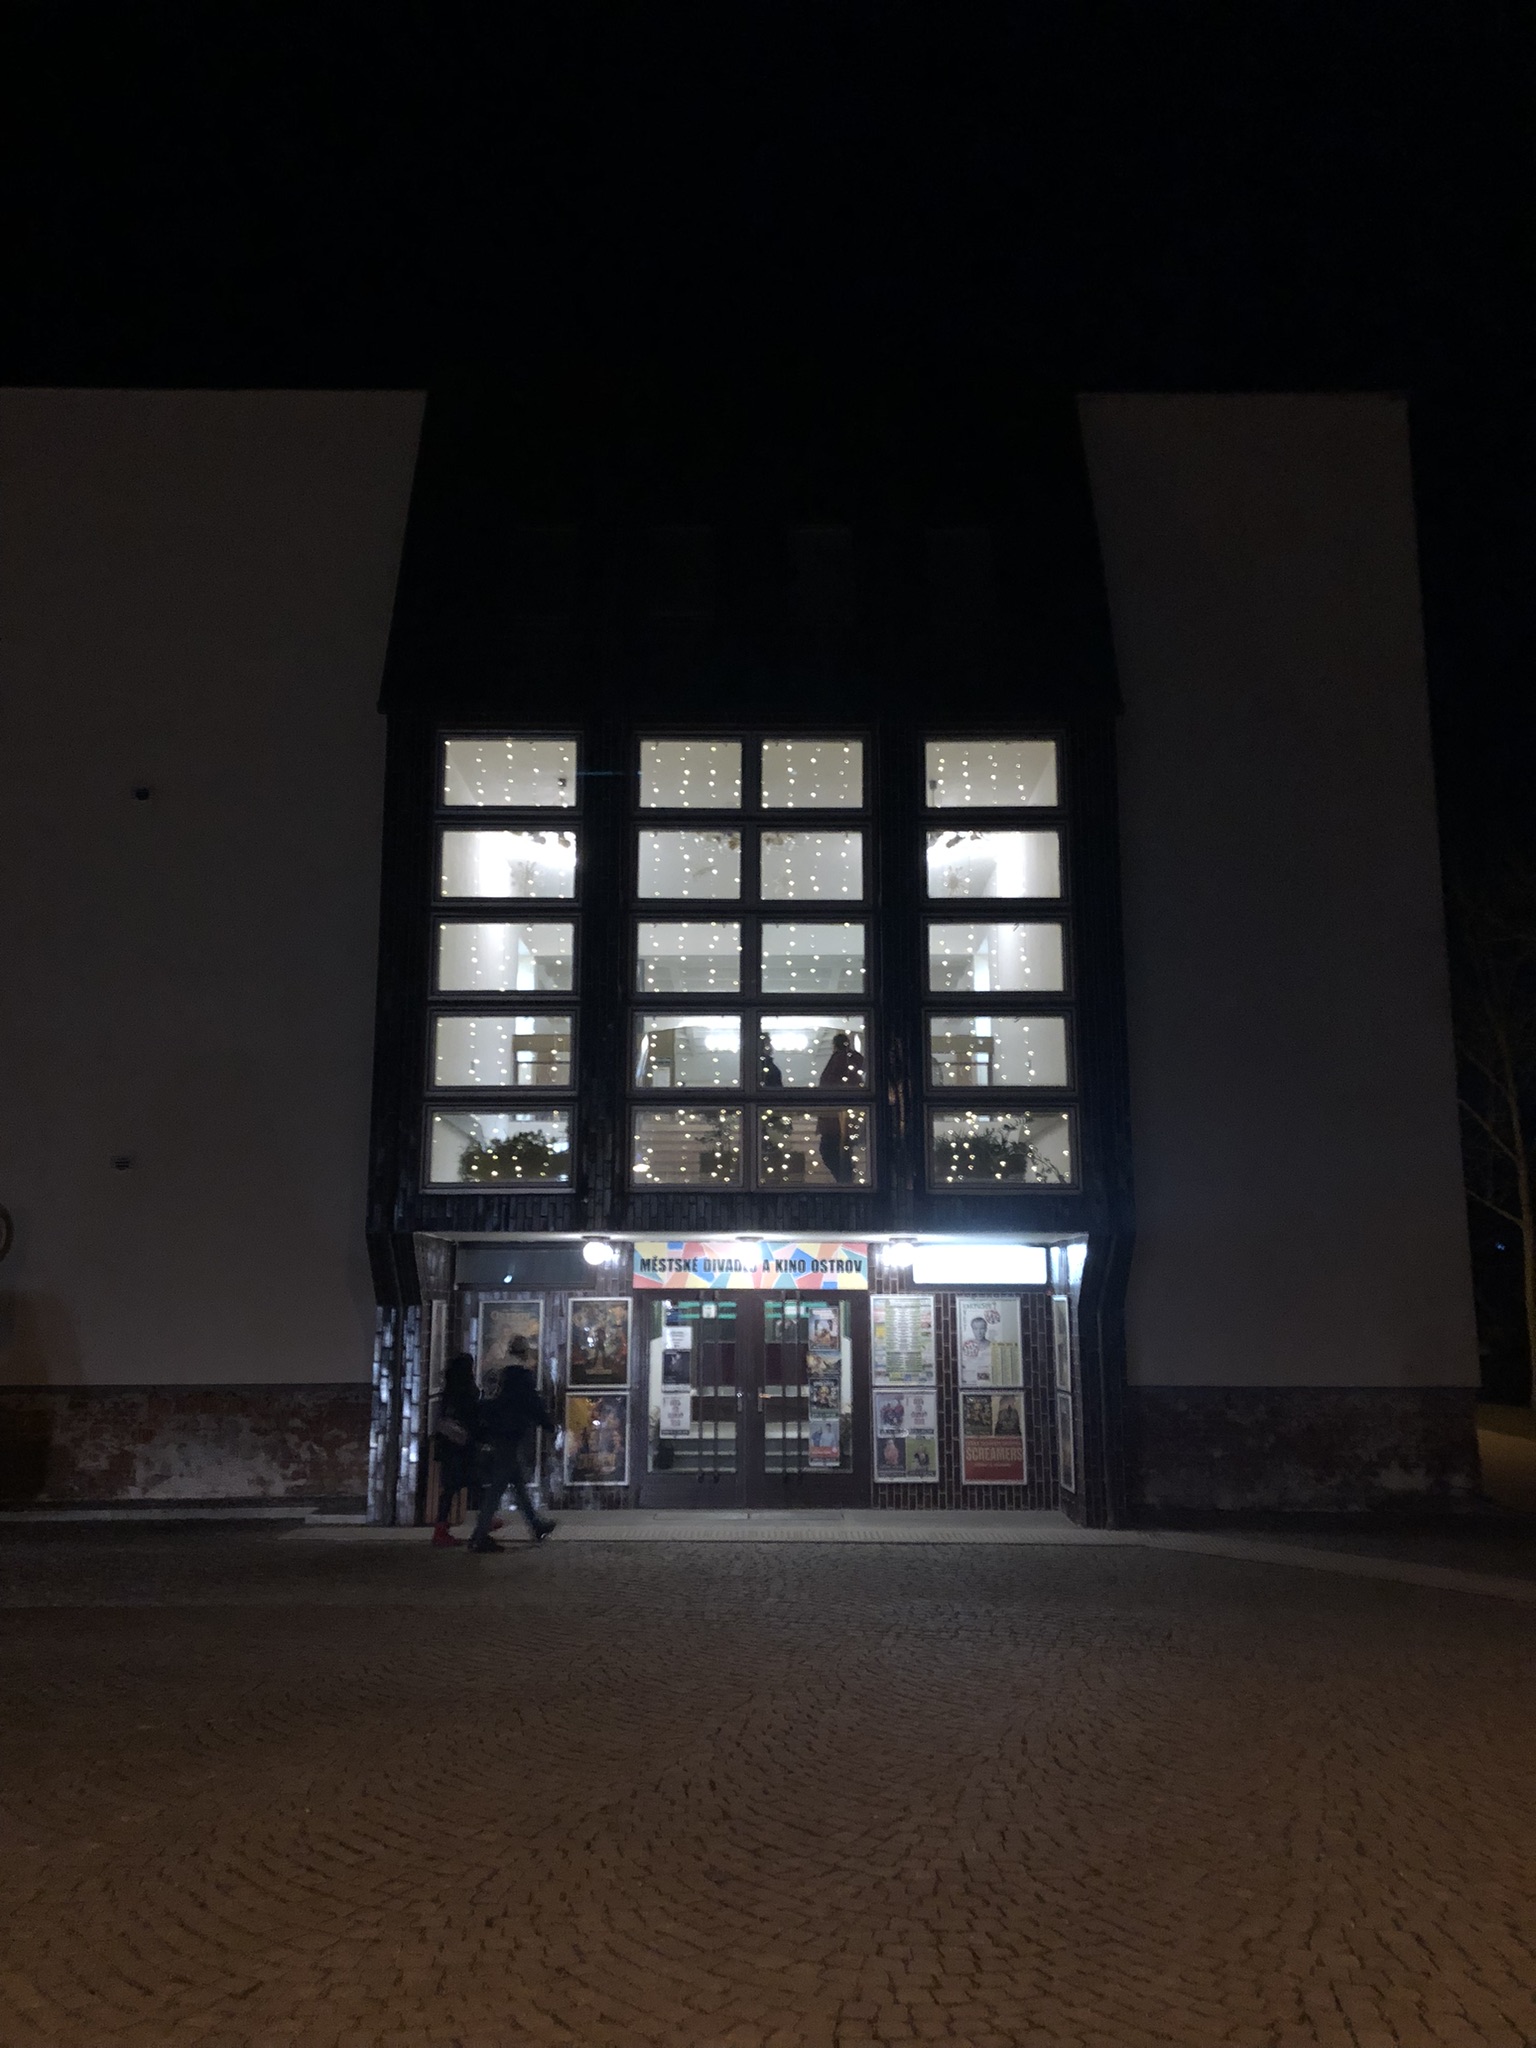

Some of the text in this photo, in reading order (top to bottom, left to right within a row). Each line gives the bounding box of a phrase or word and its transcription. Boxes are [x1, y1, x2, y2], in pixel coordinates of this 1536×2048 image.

[640, 1256, 698, 1273] MĚSTSKÉ
[763, 1259, 770, 1273] A
[775, 1259, 806, 1274] KINO
[811, 1259, 863, 1274] OSTROV
[966, 1447, 1022, 1461] SCREAMERS
